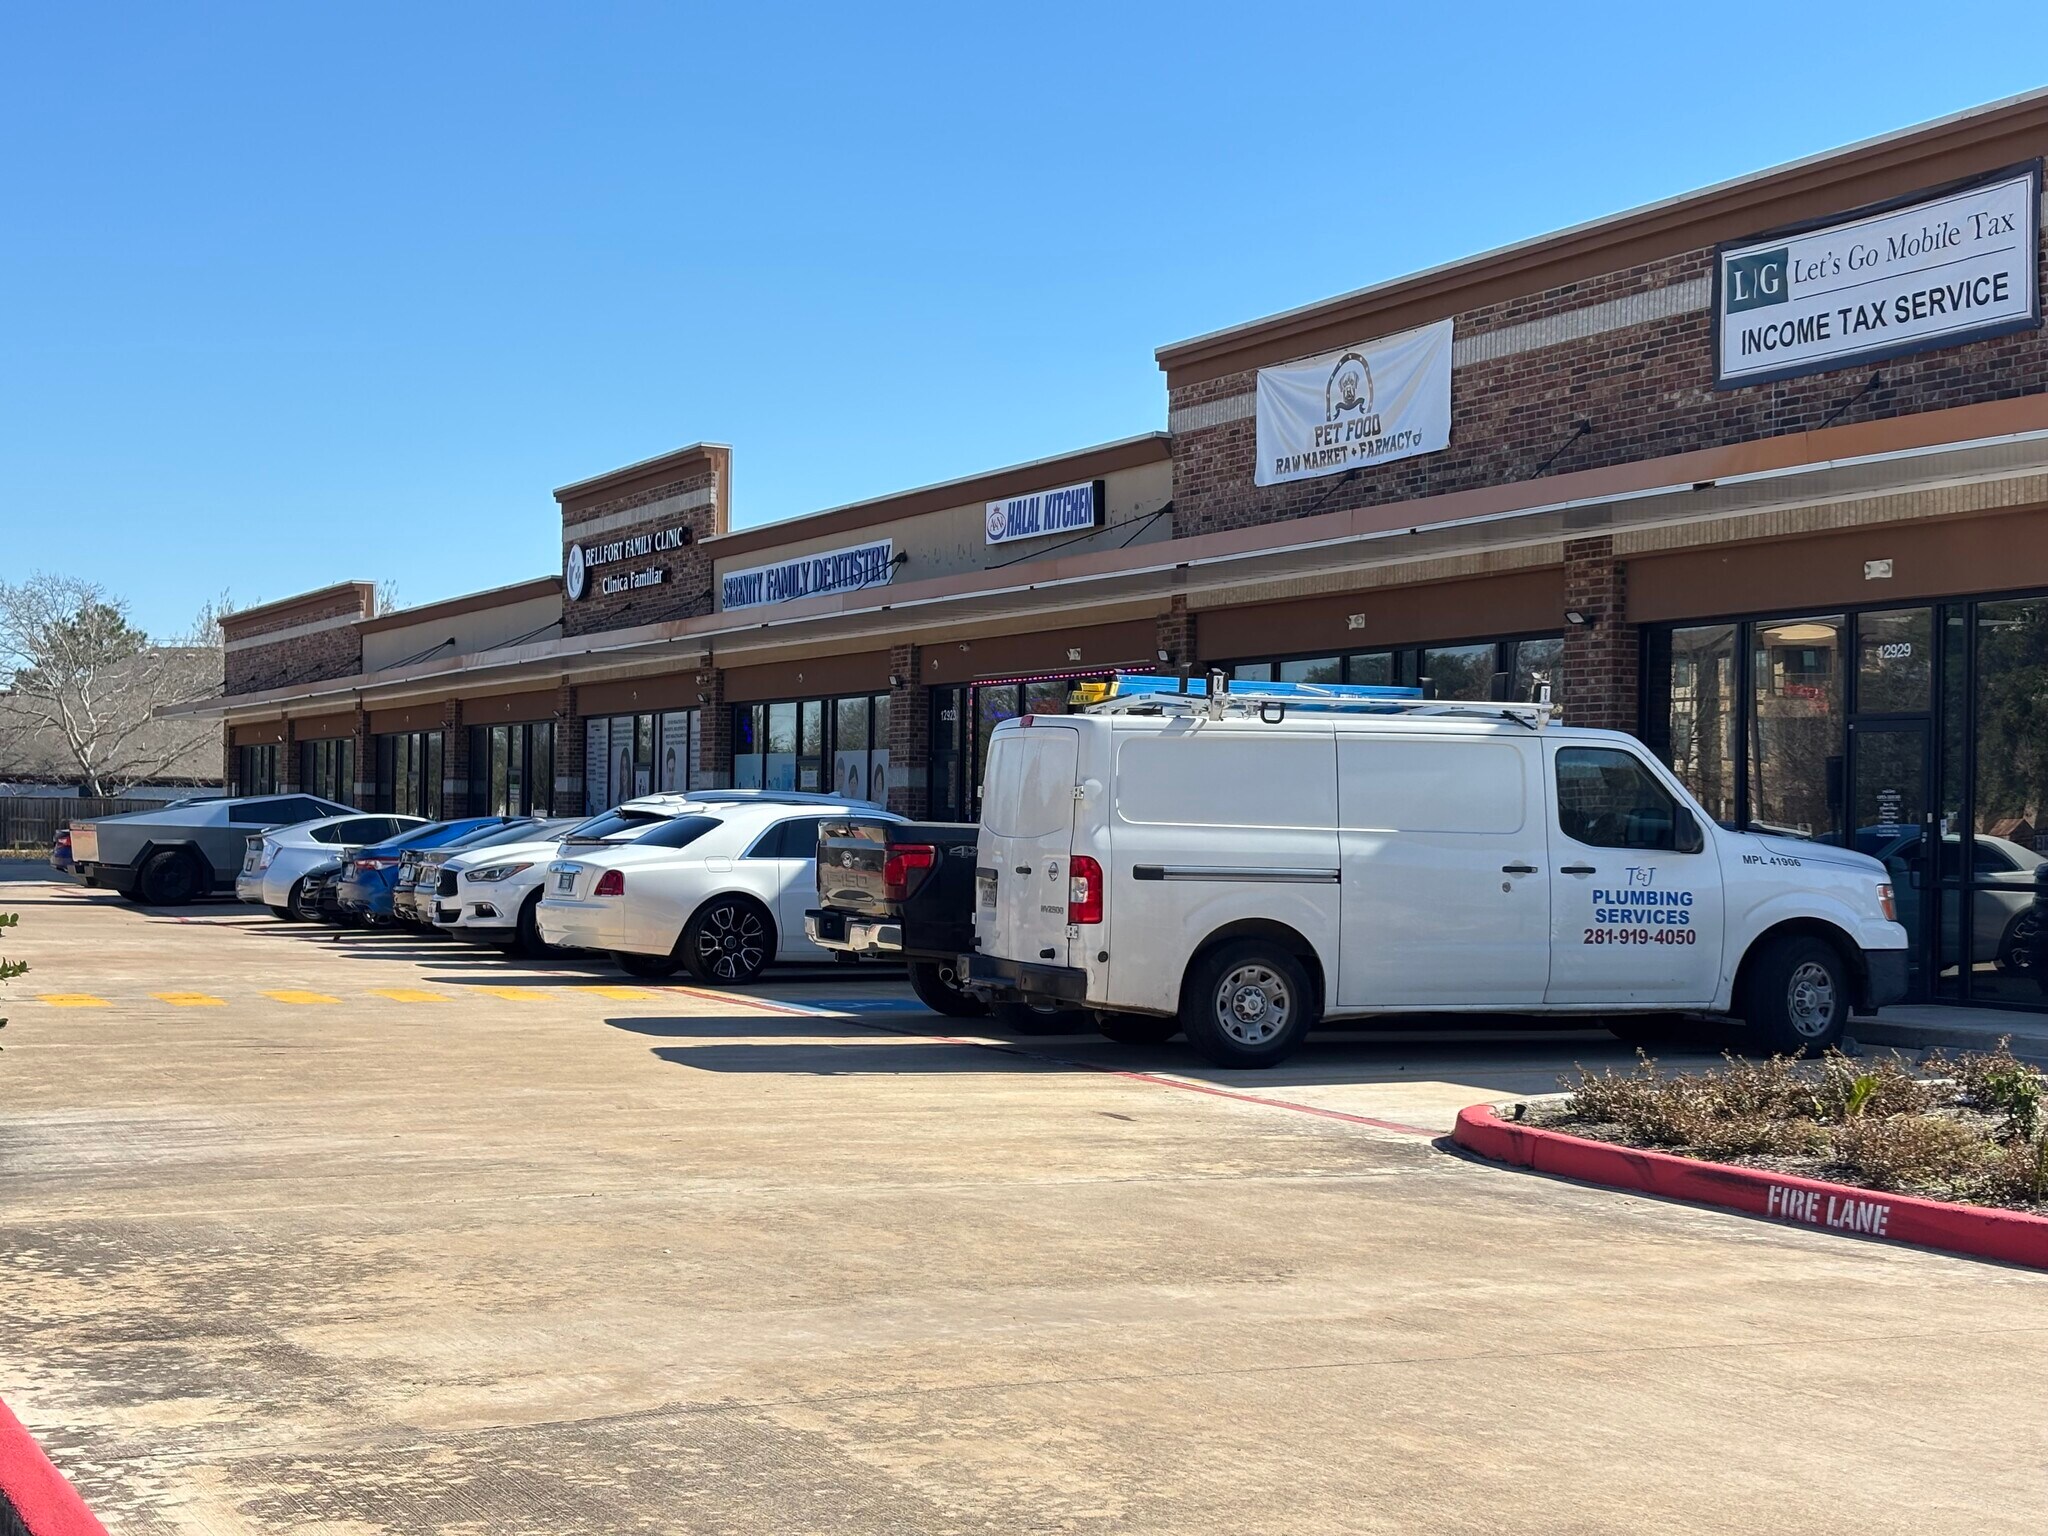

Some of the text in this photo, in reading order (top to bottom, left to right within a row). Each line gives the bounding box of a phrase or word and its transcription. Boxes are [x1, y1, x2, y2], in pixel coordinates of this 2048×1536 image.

[1794, 211, 2016, 284] Let's Go Mobile Tax
[1741, 271, 2009, 356] INCOME TAX SERVICE
[1314, 413, 1382, 447] PET FOOD
[1275, 453, 1300, 475] RAW
[1303, 446, 1348, 470] MARKET
[1358, 430, 1413, 460] FARMACY
[1006, 486, 1093, 537] HALAL KITCHEN
[585, 527, 683, 567] BELLFORT FAMILY CLINIC
[630, 566, 663, 589] Familiar
[723, 544, 891, 608] SERENITY FAMILY DENTISTRY
[1878, 642, 1911, 658] 12929
[1625, 867, 1657, 887] T&J
[1742, 854, 1801, 867] MPL 41906
[1592, 889, 1693, 907] PLUMBING
[1595, 908, 1690, 925] SERVICES
[1583, 928, 1696, 945] 281-919-4050
[1767, 1185, 1891, 1236] FIRE LANE
